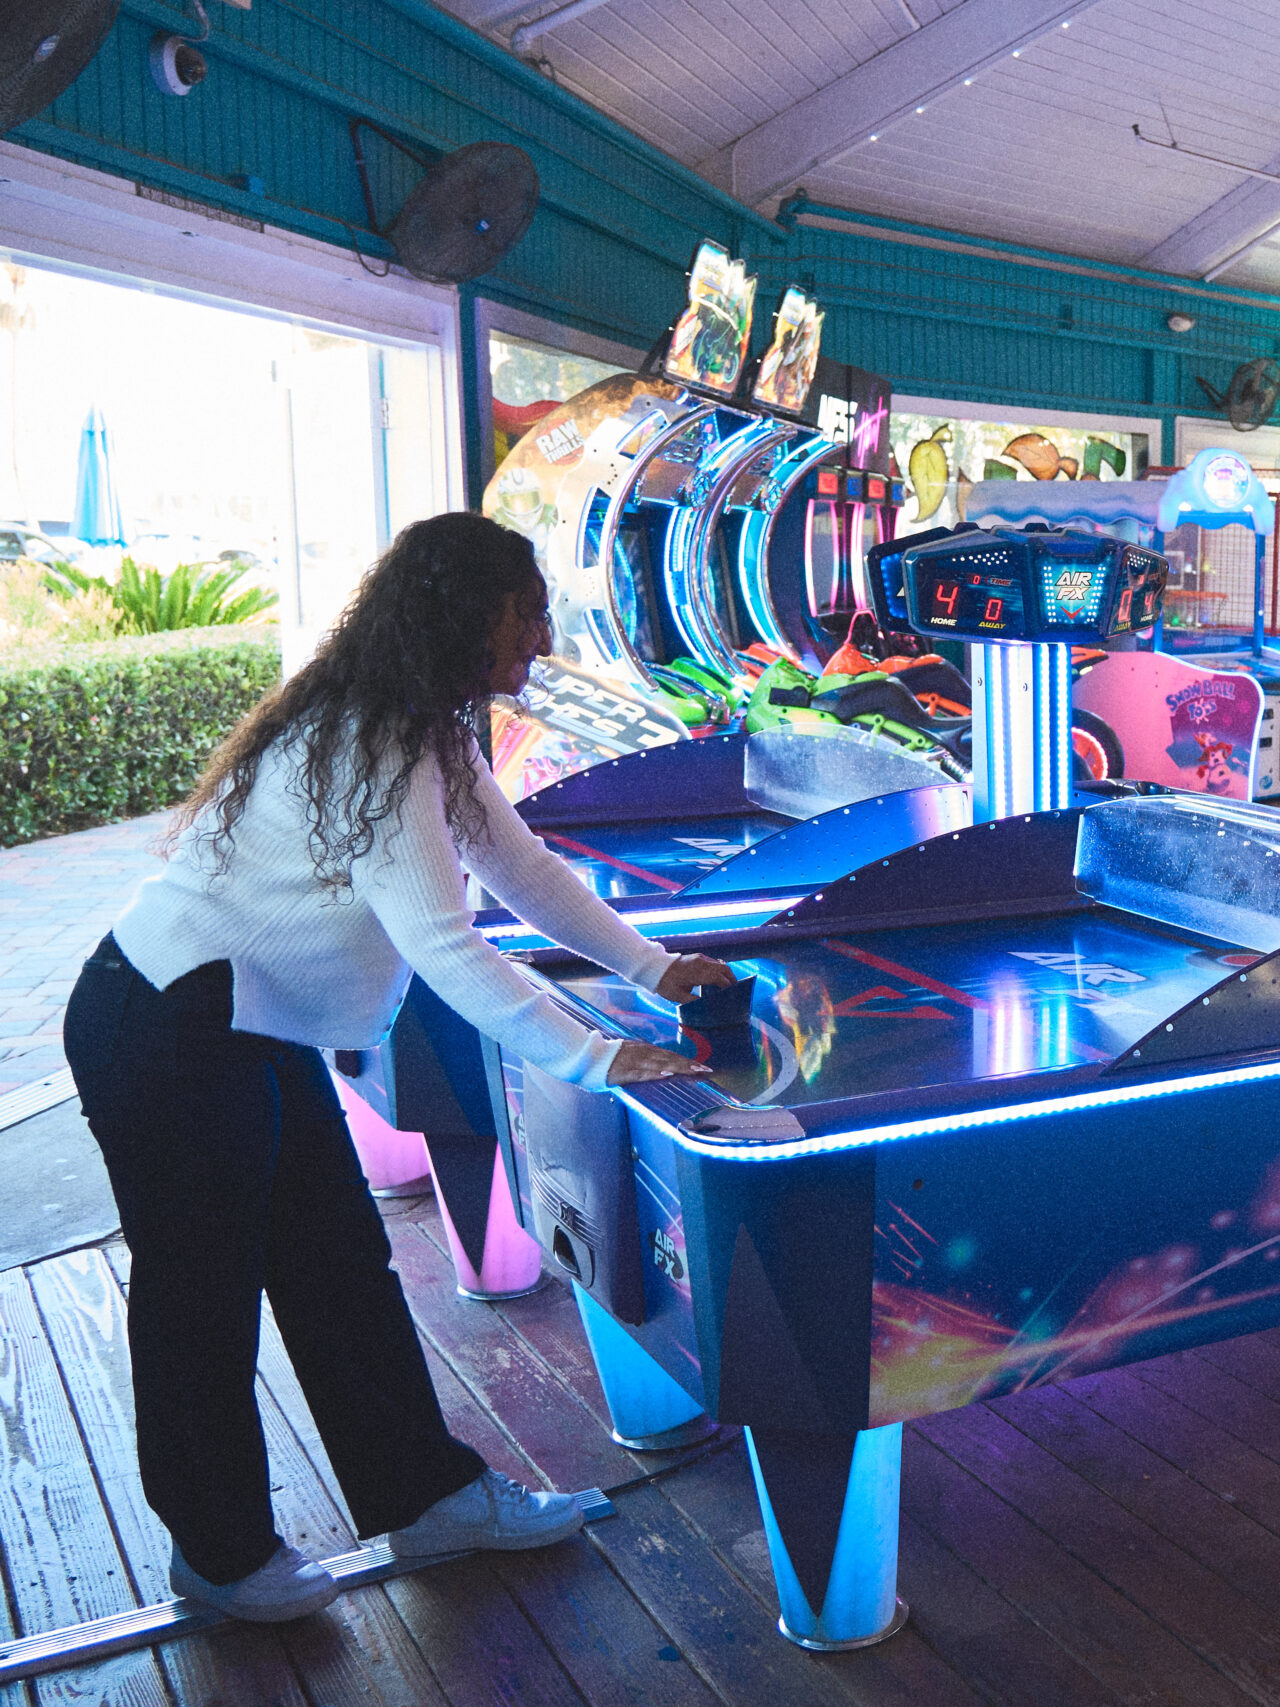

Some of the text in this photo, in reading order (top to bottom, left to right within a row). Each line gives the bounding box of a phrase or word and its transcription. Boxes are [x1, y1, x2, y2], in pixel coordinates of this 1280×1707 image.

[536, 418, 578, 455] RAW
[972, 575, 981, 585] 0
[990, 578, 1012, 586] TIME
[1054, 571, 1093, 586] AIR
[936, 584, 958, 615] 4
[1056, 586, 1091, 600] FX
[1144, 591, 1154, 612] 4
[985, 598, 1002, 620] 0
[1118, 588, 1133, 622] 0
[930, 617, 958, 626] HOME
[978, 621, 1006, 630] AWAY
[1006, 952, 1148, 988] AIR
[654, 1228, 676, 1258] AIR
[654, 1246, 679, 1285] FX
